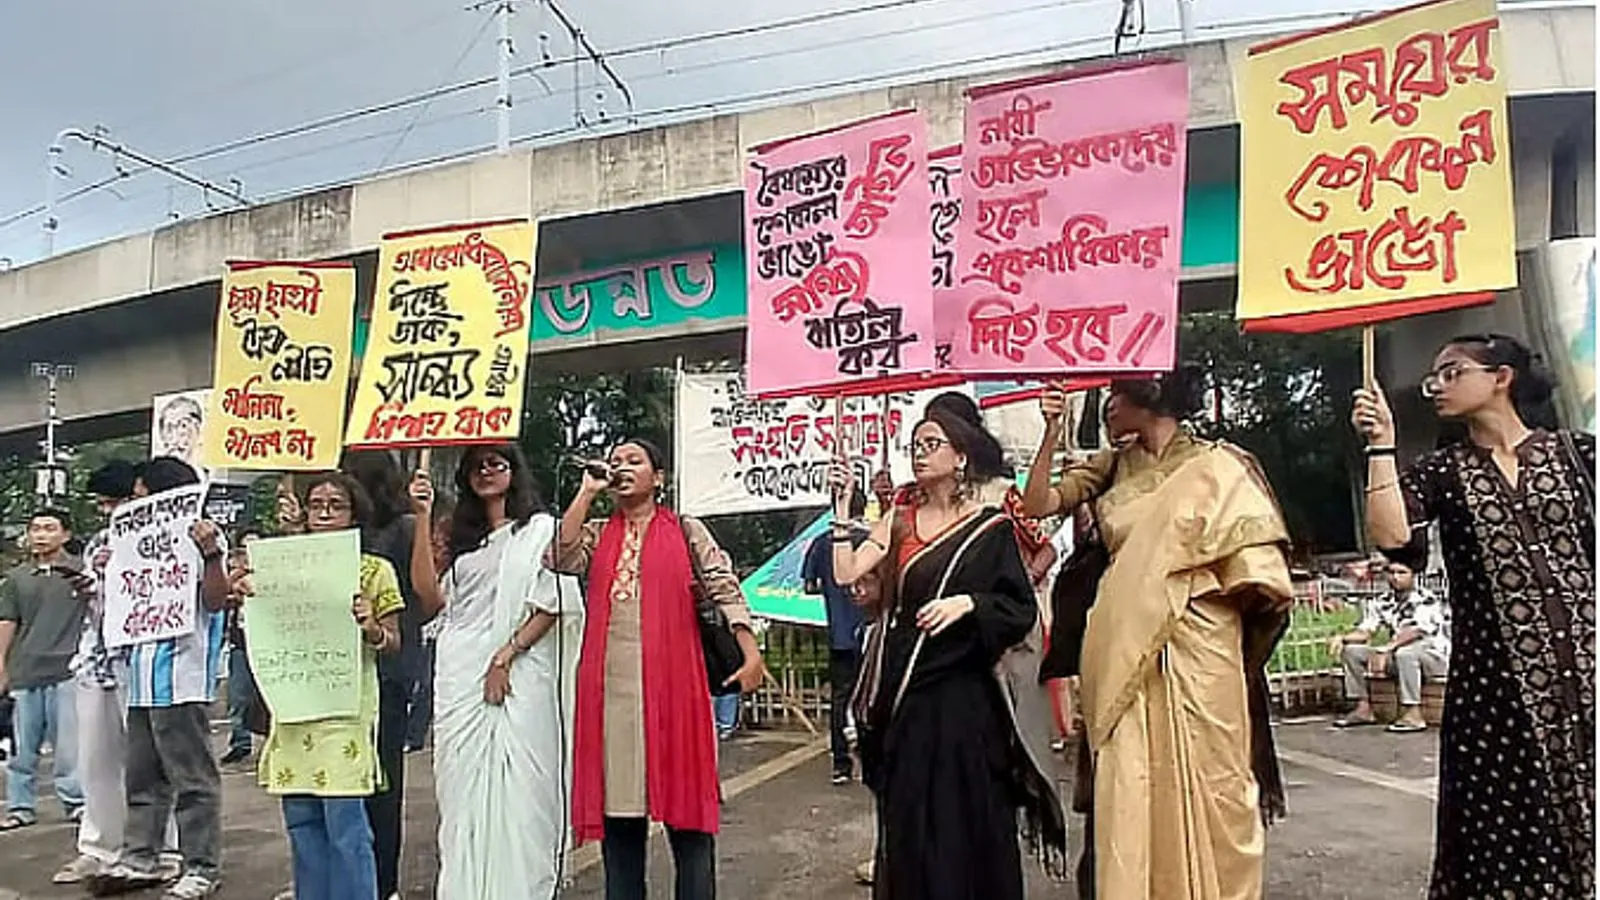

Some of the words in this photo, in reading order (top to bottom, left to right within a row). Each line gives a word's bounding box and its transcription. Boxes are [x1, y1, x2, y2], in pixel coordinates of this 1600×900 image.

[1278, 19, 1499, 133] সময়ের
[979, 94, 1053, 145] নারী
[749, 154, 848, 207] বৈষম্যের
[971, 123, 1178, 190] অভিভাবকদের
[753, 193, 837, 246] শেকল
[975, 188, 1047, 243] হলে
[961, 214, 1169, 295] প্রবেশাধিকার
[804, 297, 903, 348] বাতিল
[967, 297, 1040, 364] দিতে
[374, 348, 481, 404] সান্ধ্য
